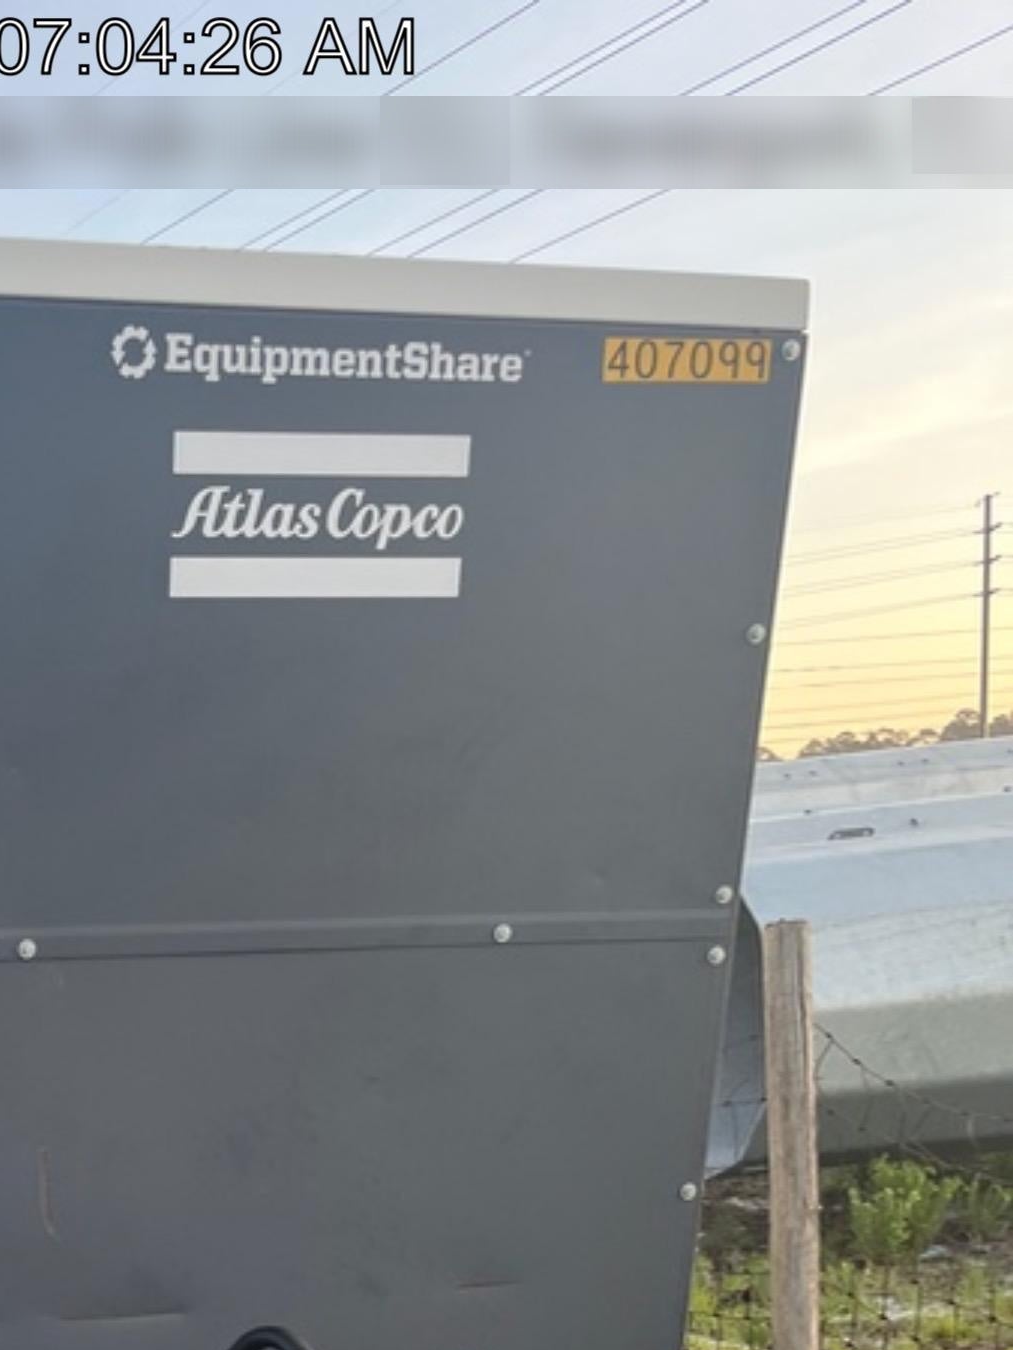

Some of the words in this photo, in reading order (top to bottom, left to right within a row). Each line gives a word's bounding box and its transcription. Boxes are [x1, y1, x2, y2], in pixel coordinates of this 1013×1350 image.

[165, 332, 523, 384] EquipmentShare
[607, 340, 767, 379] 407099
[172, 485, 322, 540] Atlas
[328, 487, 464, 549] Copco
